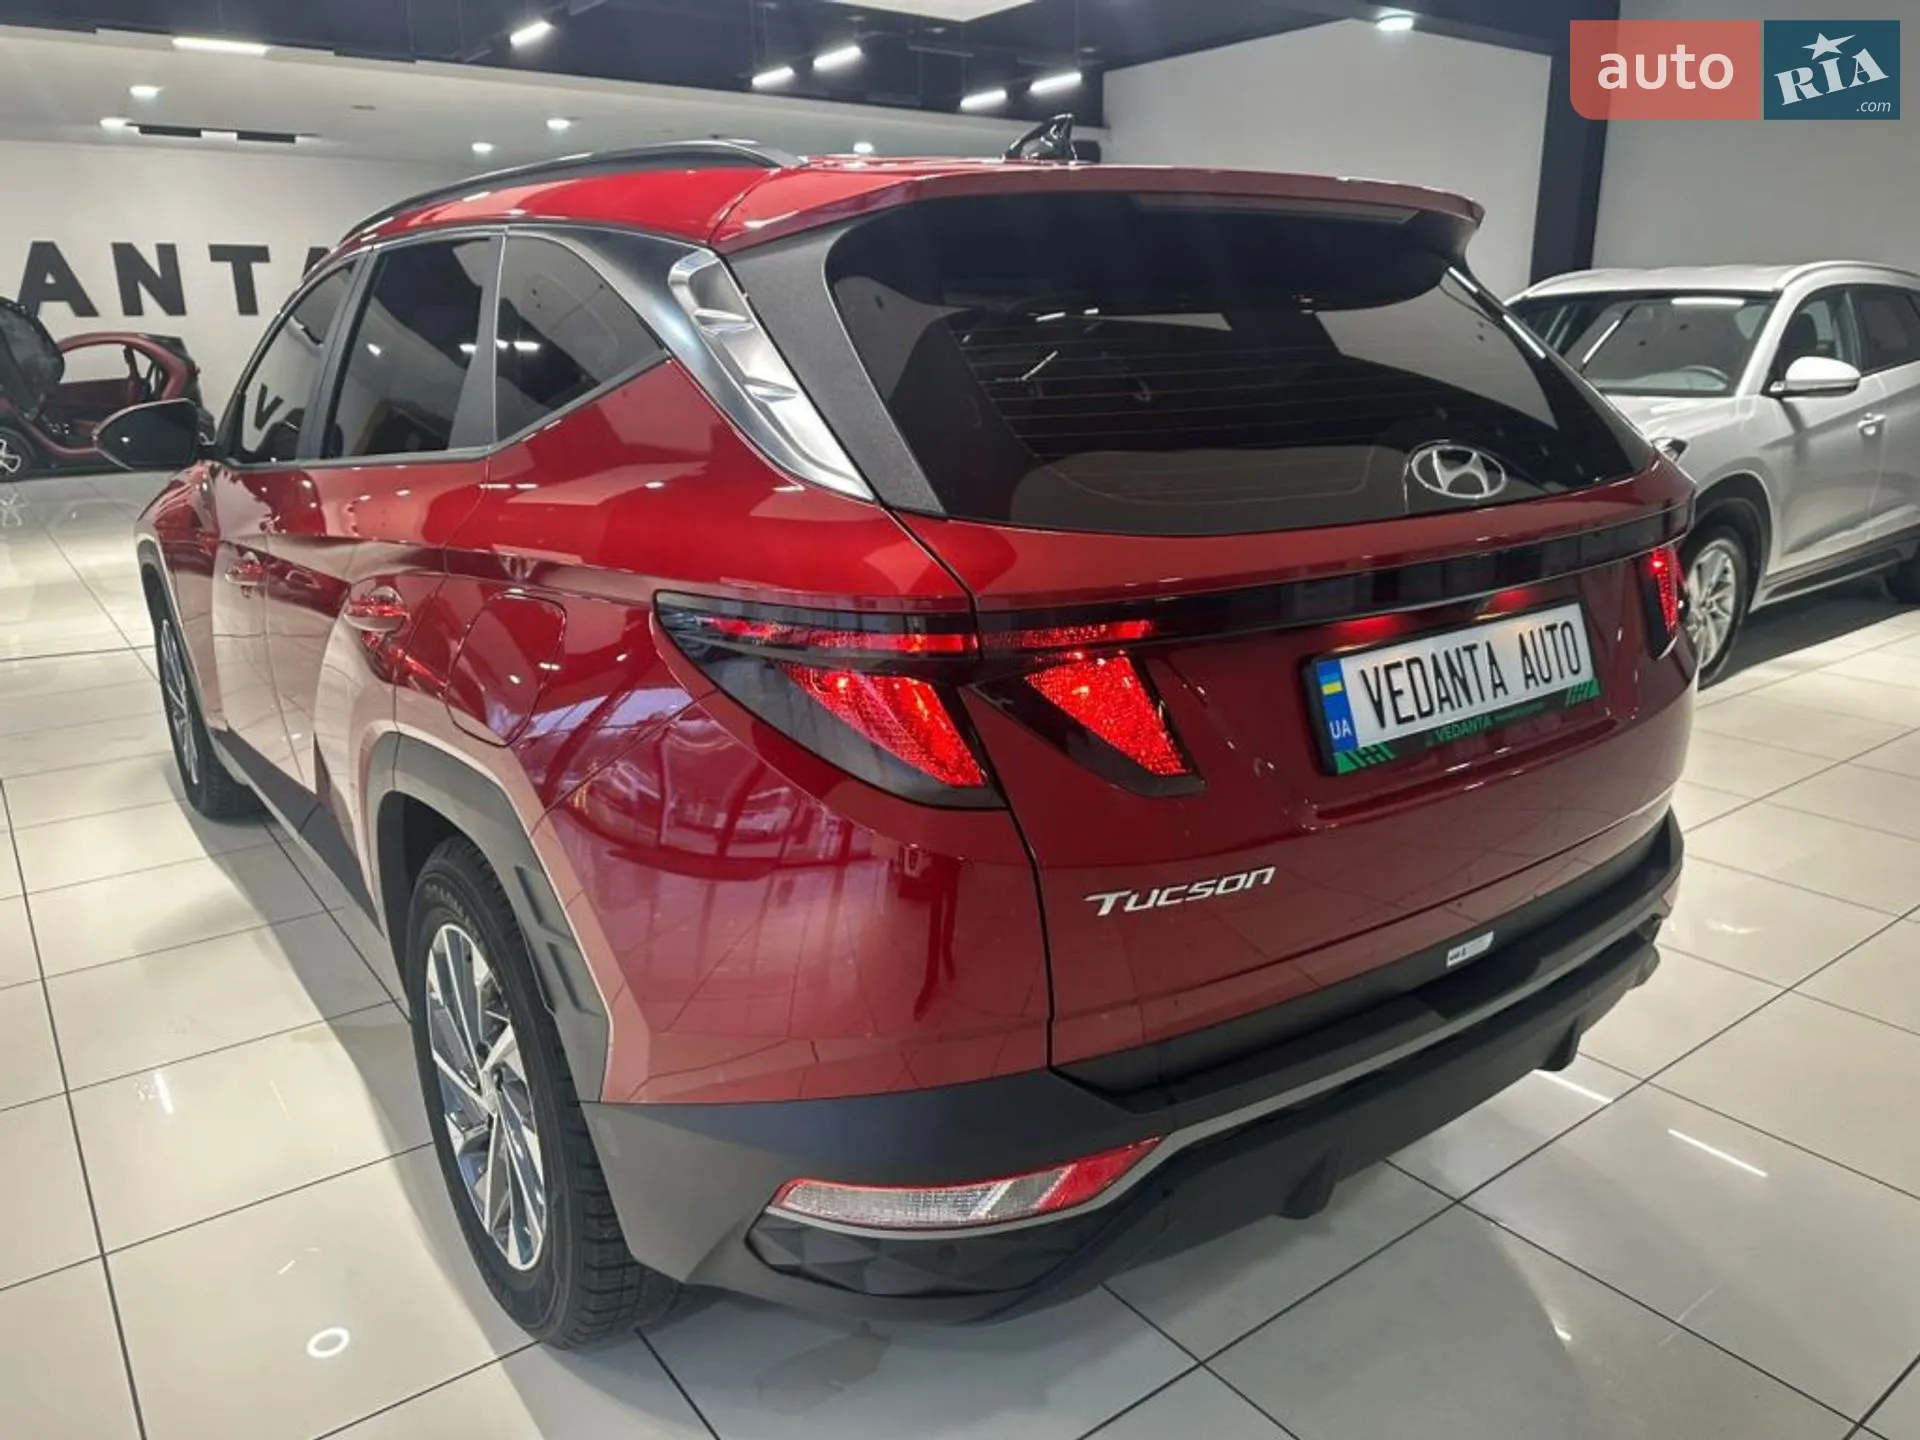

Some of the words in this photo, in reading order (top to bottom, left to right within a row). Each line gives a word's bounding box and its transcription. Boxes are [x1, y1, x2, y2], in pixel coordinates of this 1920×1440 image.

[1360, 641, 1508, 729] VEDANTA
[1518, 620, 1582, 690] AUTO
[1329, 720, 1352, 739] UA
